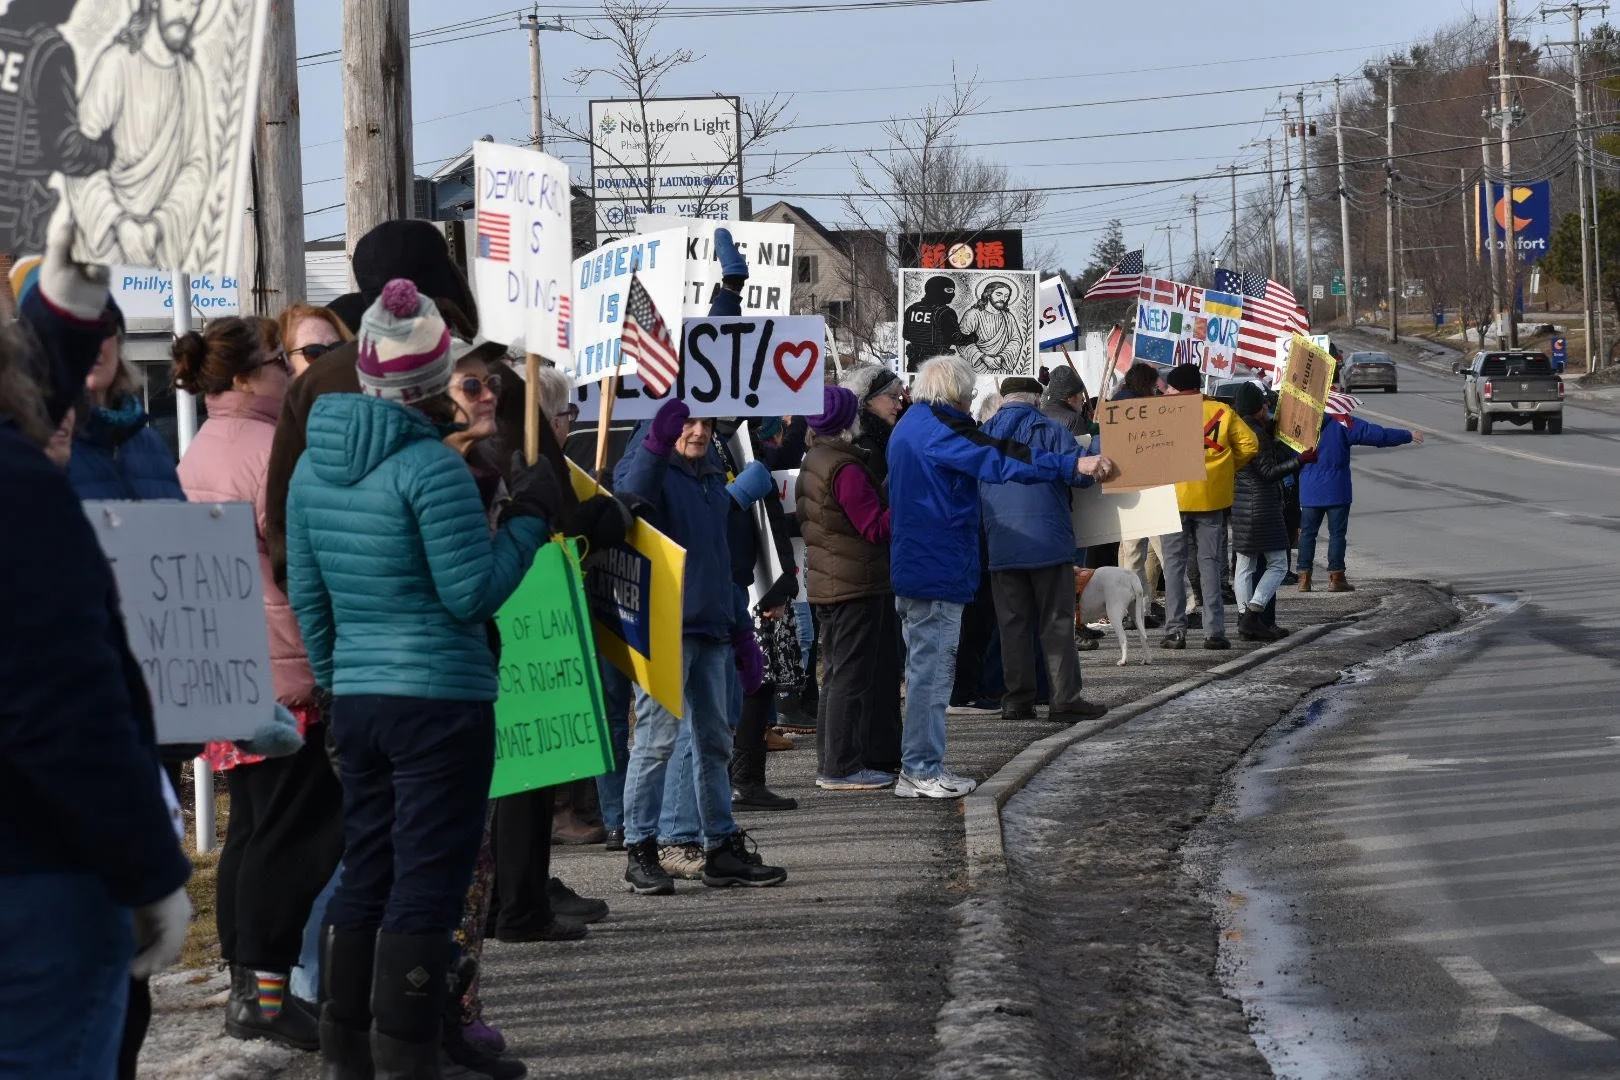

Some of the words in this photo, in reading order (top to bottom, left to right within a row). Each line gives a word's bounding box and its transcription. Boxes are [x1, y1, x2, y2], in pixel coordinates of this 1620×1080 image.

[620, 119, 689, 133] Nothern
[694, 117, 730, 136] Light
[625, 205, 666, 214] Ellswrth
[678, 203, 729, 213] VISTOR
[758, 242, 790, 266] NO
[1485, 236, 1545, 250] Cofort
[580, 240, 661, 289] DISSENT
[599, 293, 620, 323] IS
[1175, 284, 1204, 313] WE
[910, 311, 932, 324] ICE
[1138, 304, 1169, 332] NEED
[1207, 317, 1239, 348] OUR
[1106, 404, 1148, 424] ICE
[1158, 405, 1186, 415] OUT
[151, 553, 253, 601] STAND
[138, 606, 220, 650] WITH
[512, 615, 531, 641] OF
[538, 609, 575, 640] LAW
[499, 663, 526, 695] OR
[528, 657, 584, 693] RIGHTS
[534, 711, 596, 755] JUSTICE
